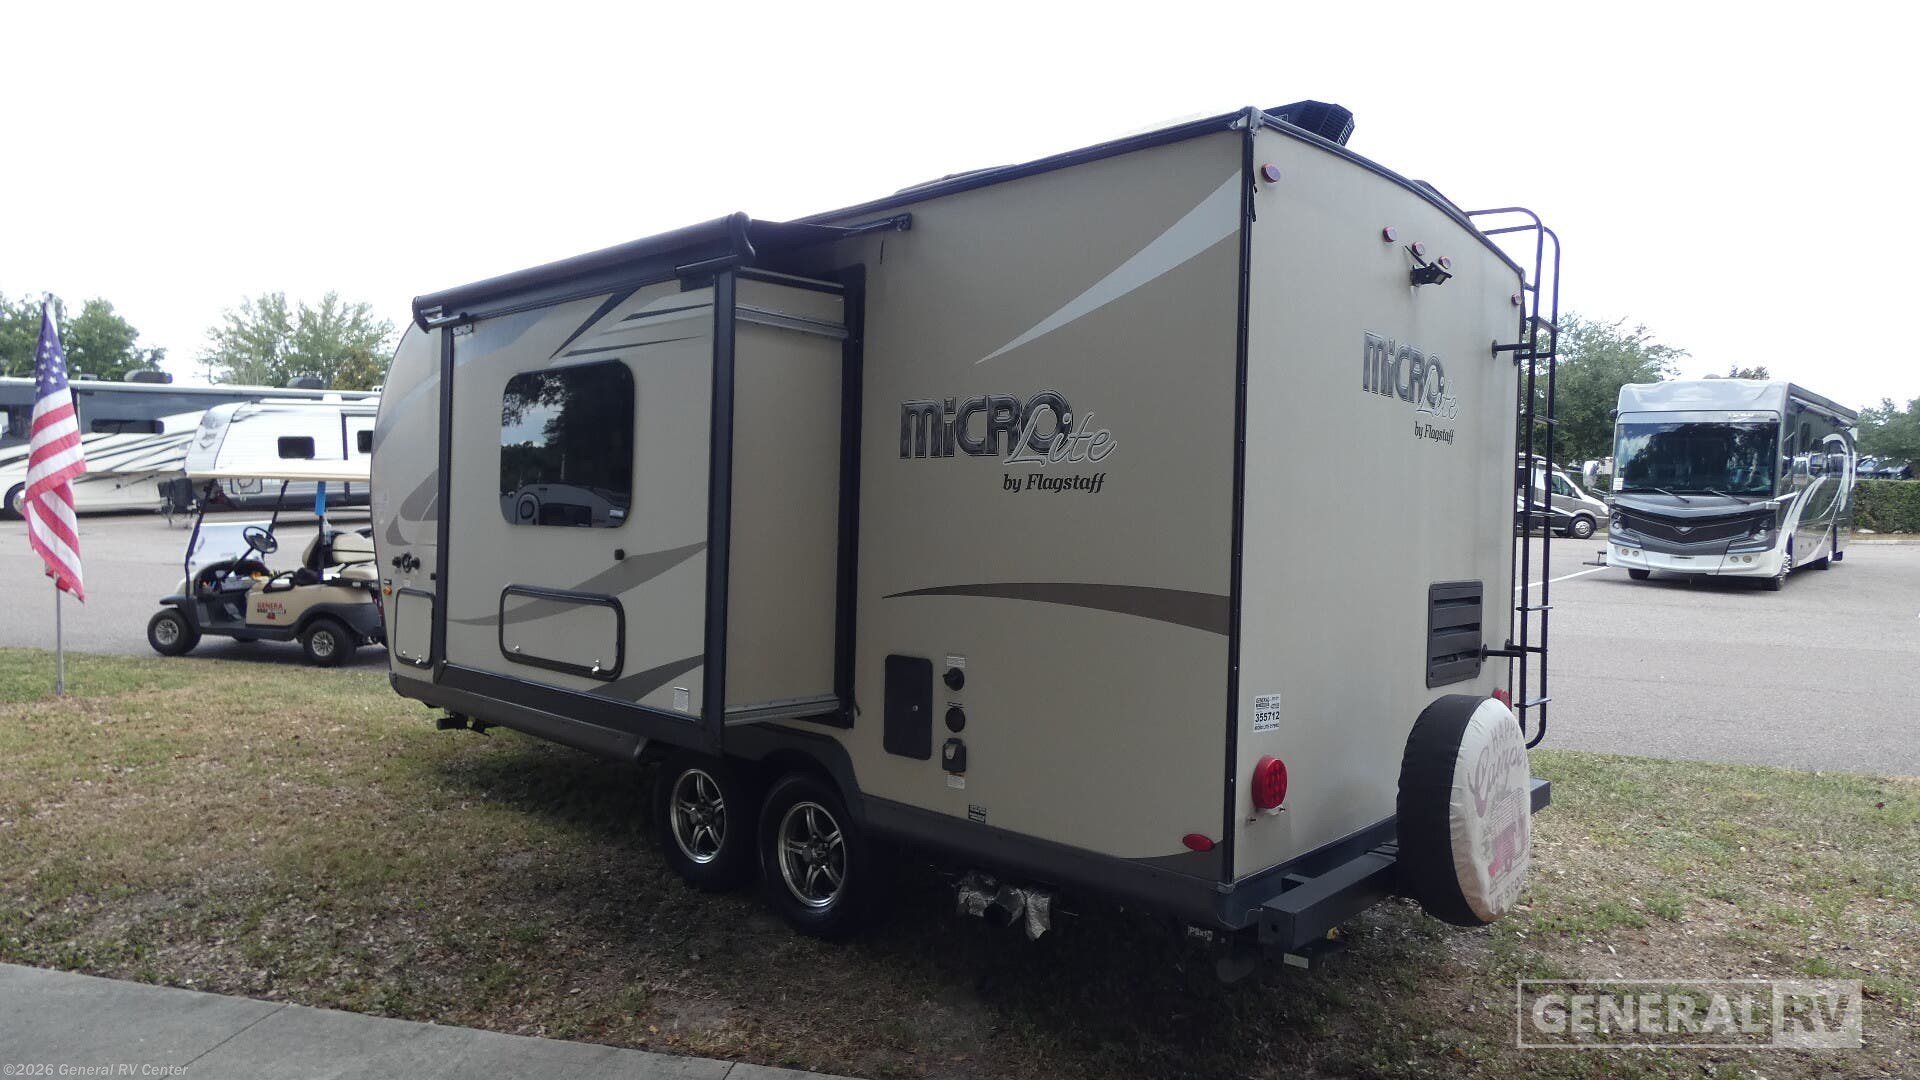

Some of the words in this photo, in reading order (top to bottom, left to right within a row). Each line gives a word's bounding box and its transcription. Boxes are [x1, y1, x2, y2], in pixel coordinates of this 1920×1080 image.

[1002, 404, 1117, 467] Lite
[1414, 421, 1424, 439] by
[1424, 424, 1455, 446] Flagstaff
[1003, 473, 1022, 493] by
[1025, 473, 1105, 494] Flagstaff
[1254, 711, 1280, 723] 355712
